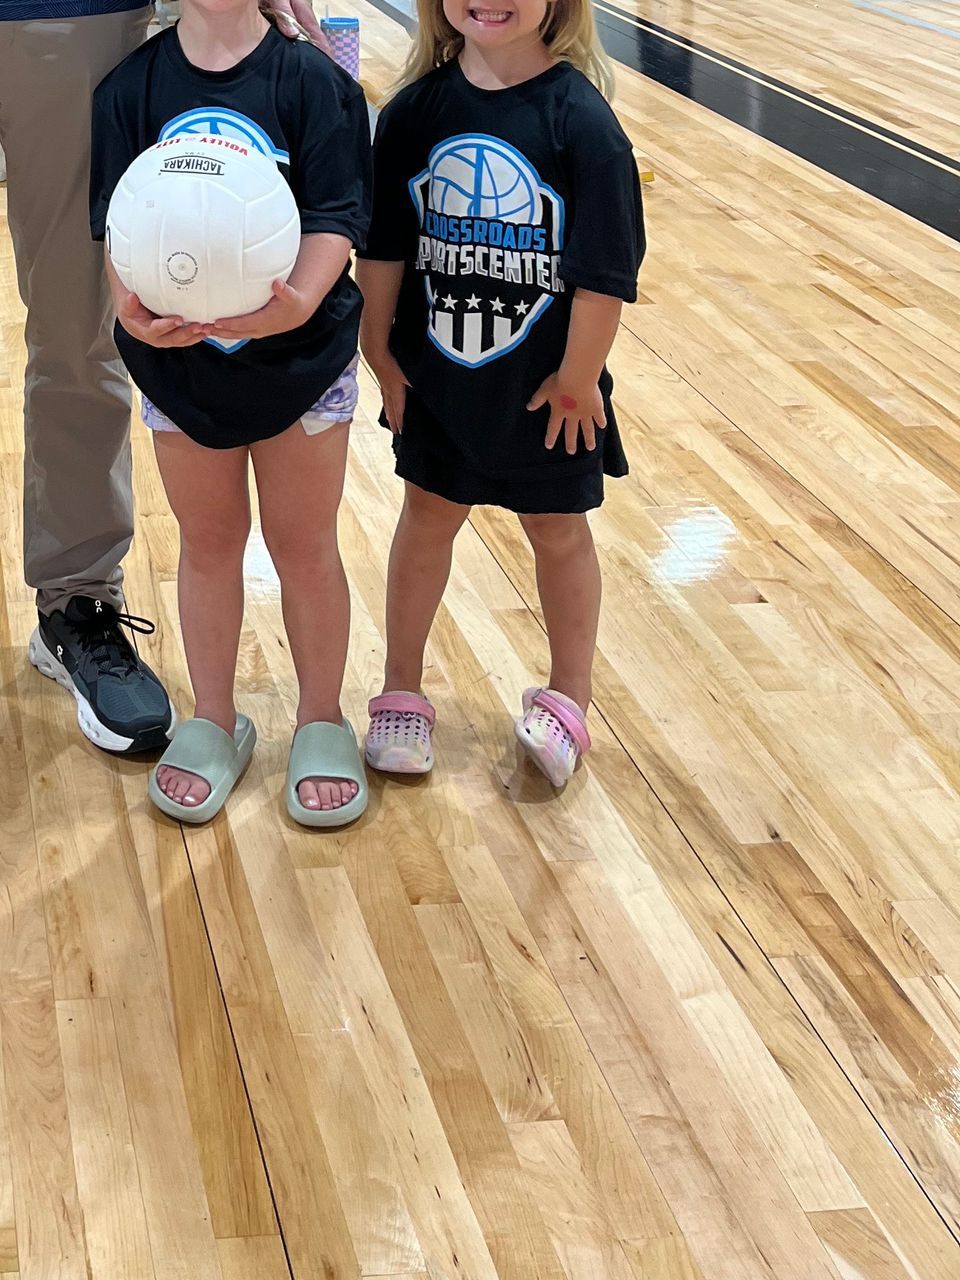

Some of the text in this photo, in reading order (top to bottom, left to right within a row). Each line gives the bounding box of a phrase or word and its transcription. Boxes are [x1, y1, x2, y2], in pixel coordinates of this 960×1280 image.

[200, 137, 248, 156] VOLLEY
[162, 157, 224, 175] TACHIKARA
[425, 211, 547, 251] CROSSROADS
